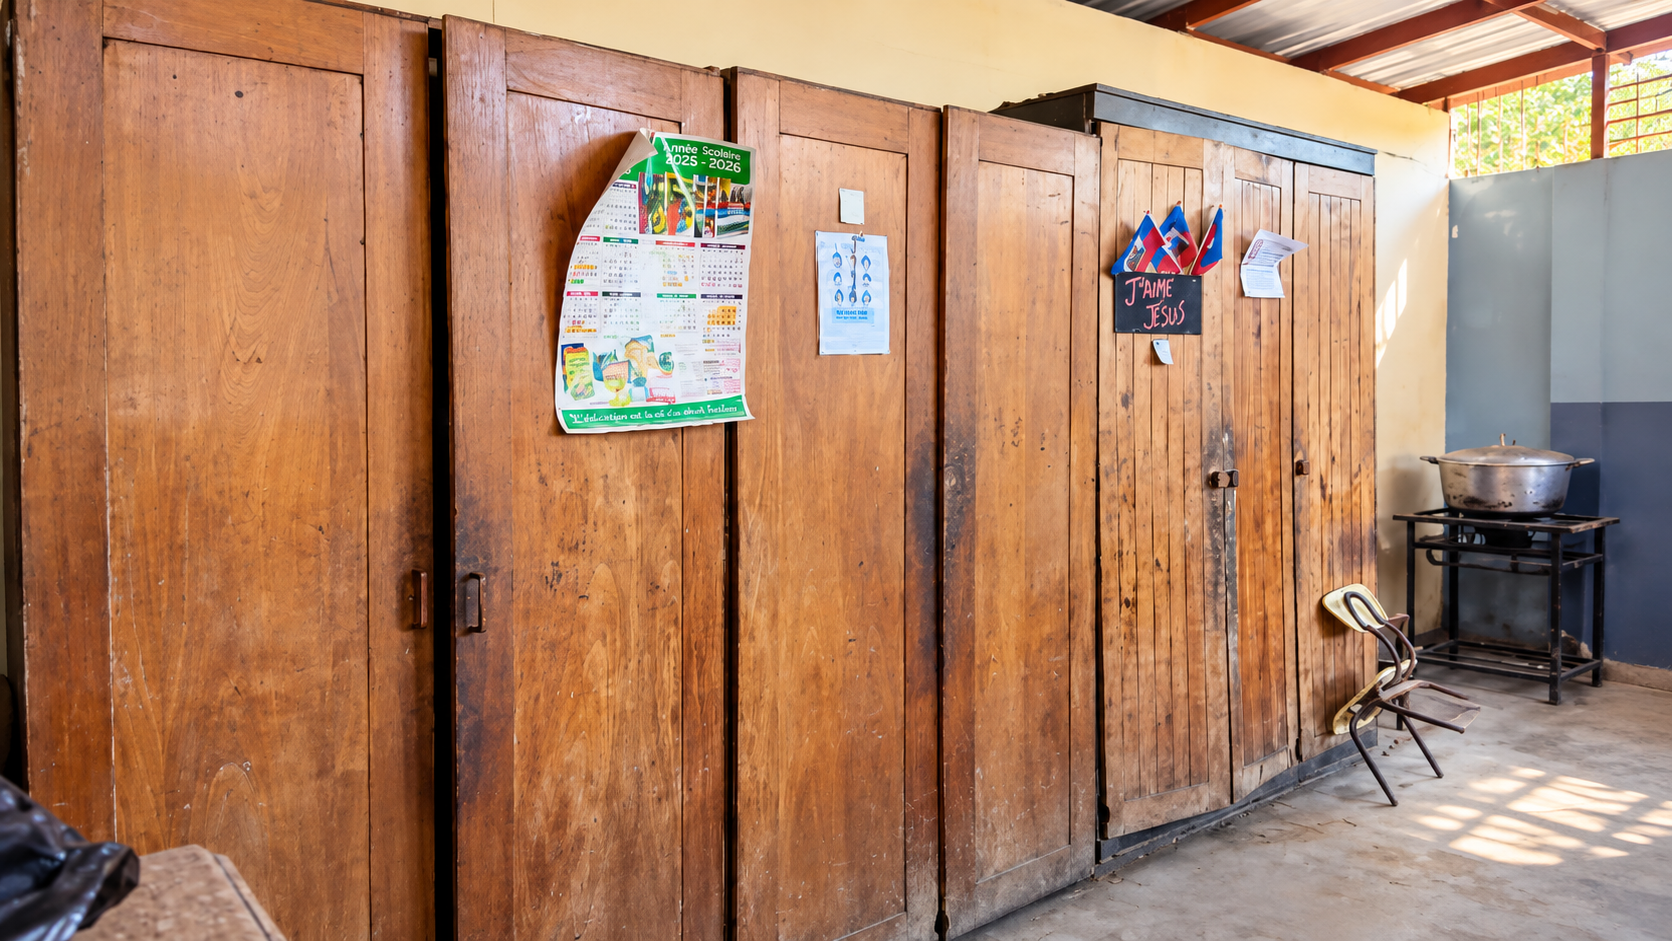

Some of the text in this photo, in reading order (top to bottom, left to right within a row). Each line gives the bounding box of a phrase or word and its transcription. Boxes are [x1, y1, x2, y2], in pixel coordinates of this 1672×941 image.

[665, 153, 698, 167] 2025
[708, 158, 742, 173] 2026
[702, 146, 741, 161] Scolaire
[1125, 276, 1174, 306] J'AIME
